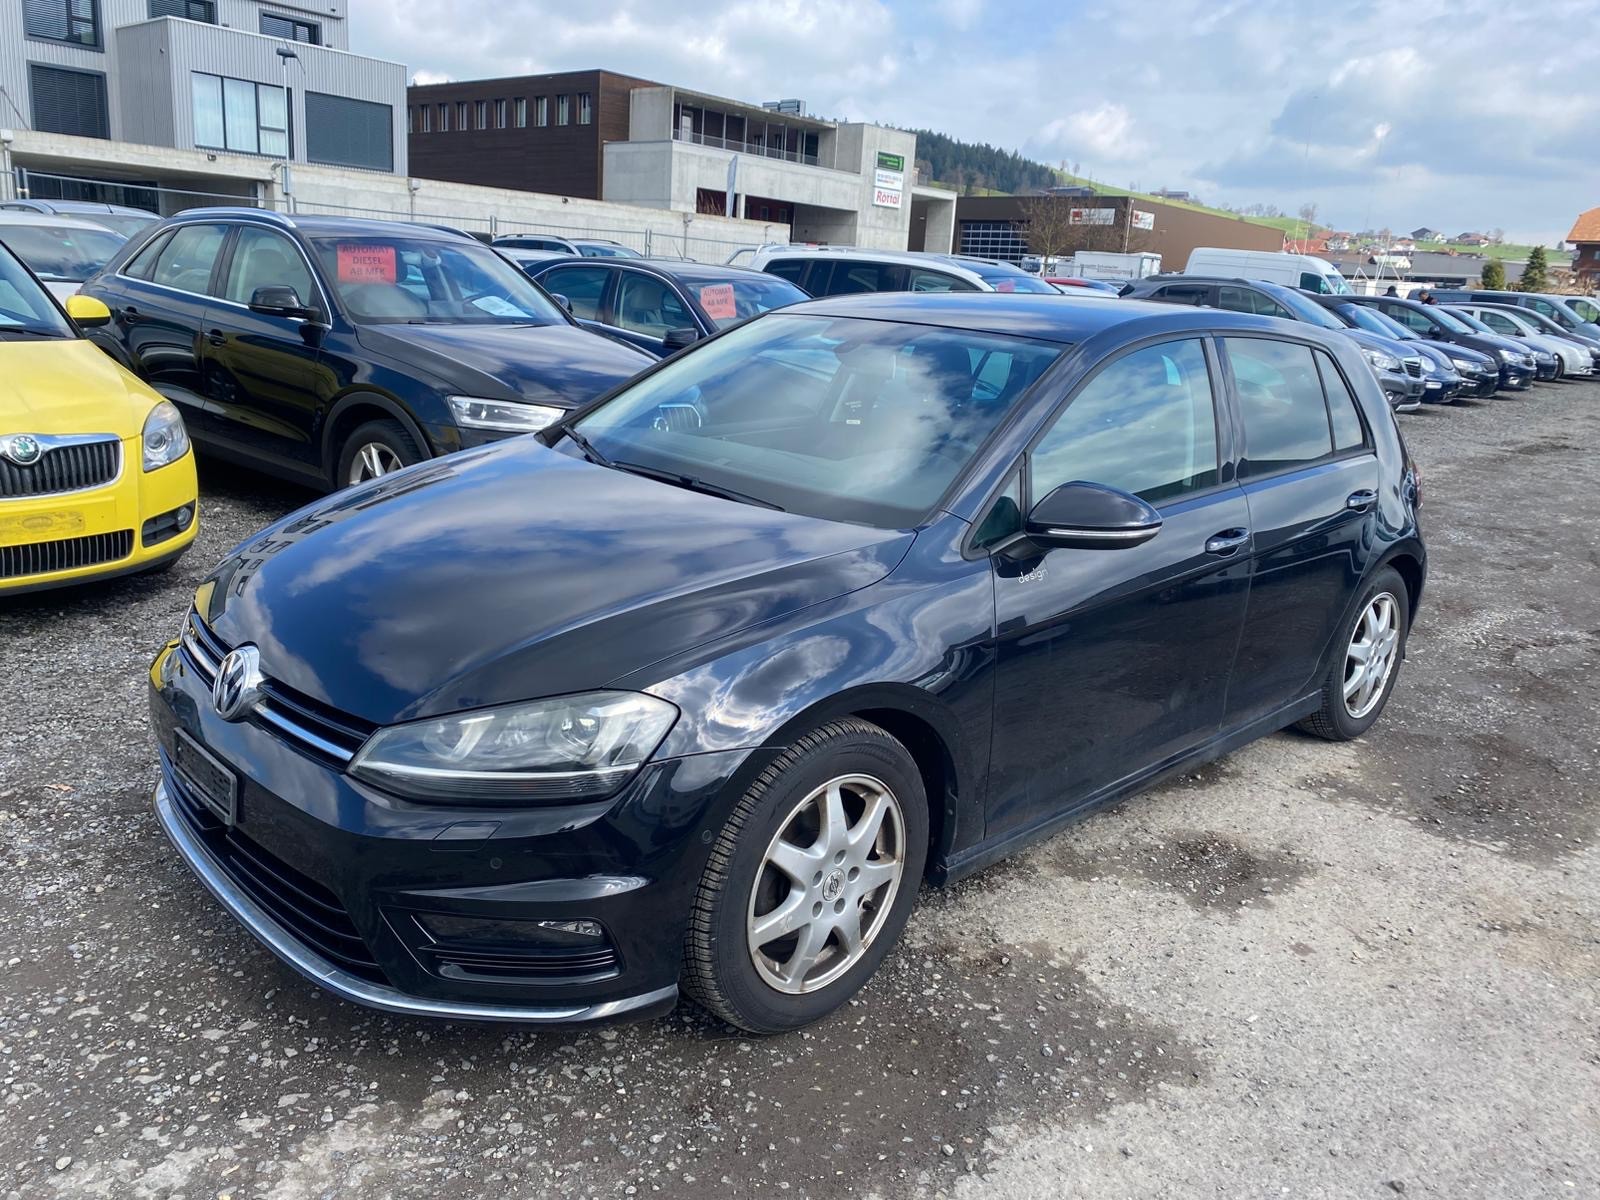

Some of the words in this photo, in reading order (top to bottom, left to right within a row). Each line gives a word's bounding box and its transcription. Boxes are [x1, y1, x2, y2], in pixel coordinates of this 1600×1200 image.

[342, 245, 389, 254] AUTOMAT
[352, 256, 383, 264] DIESEL
[703, 287, 731, 296] AUTOMAT
[1018, 567, 1048, 583] design
